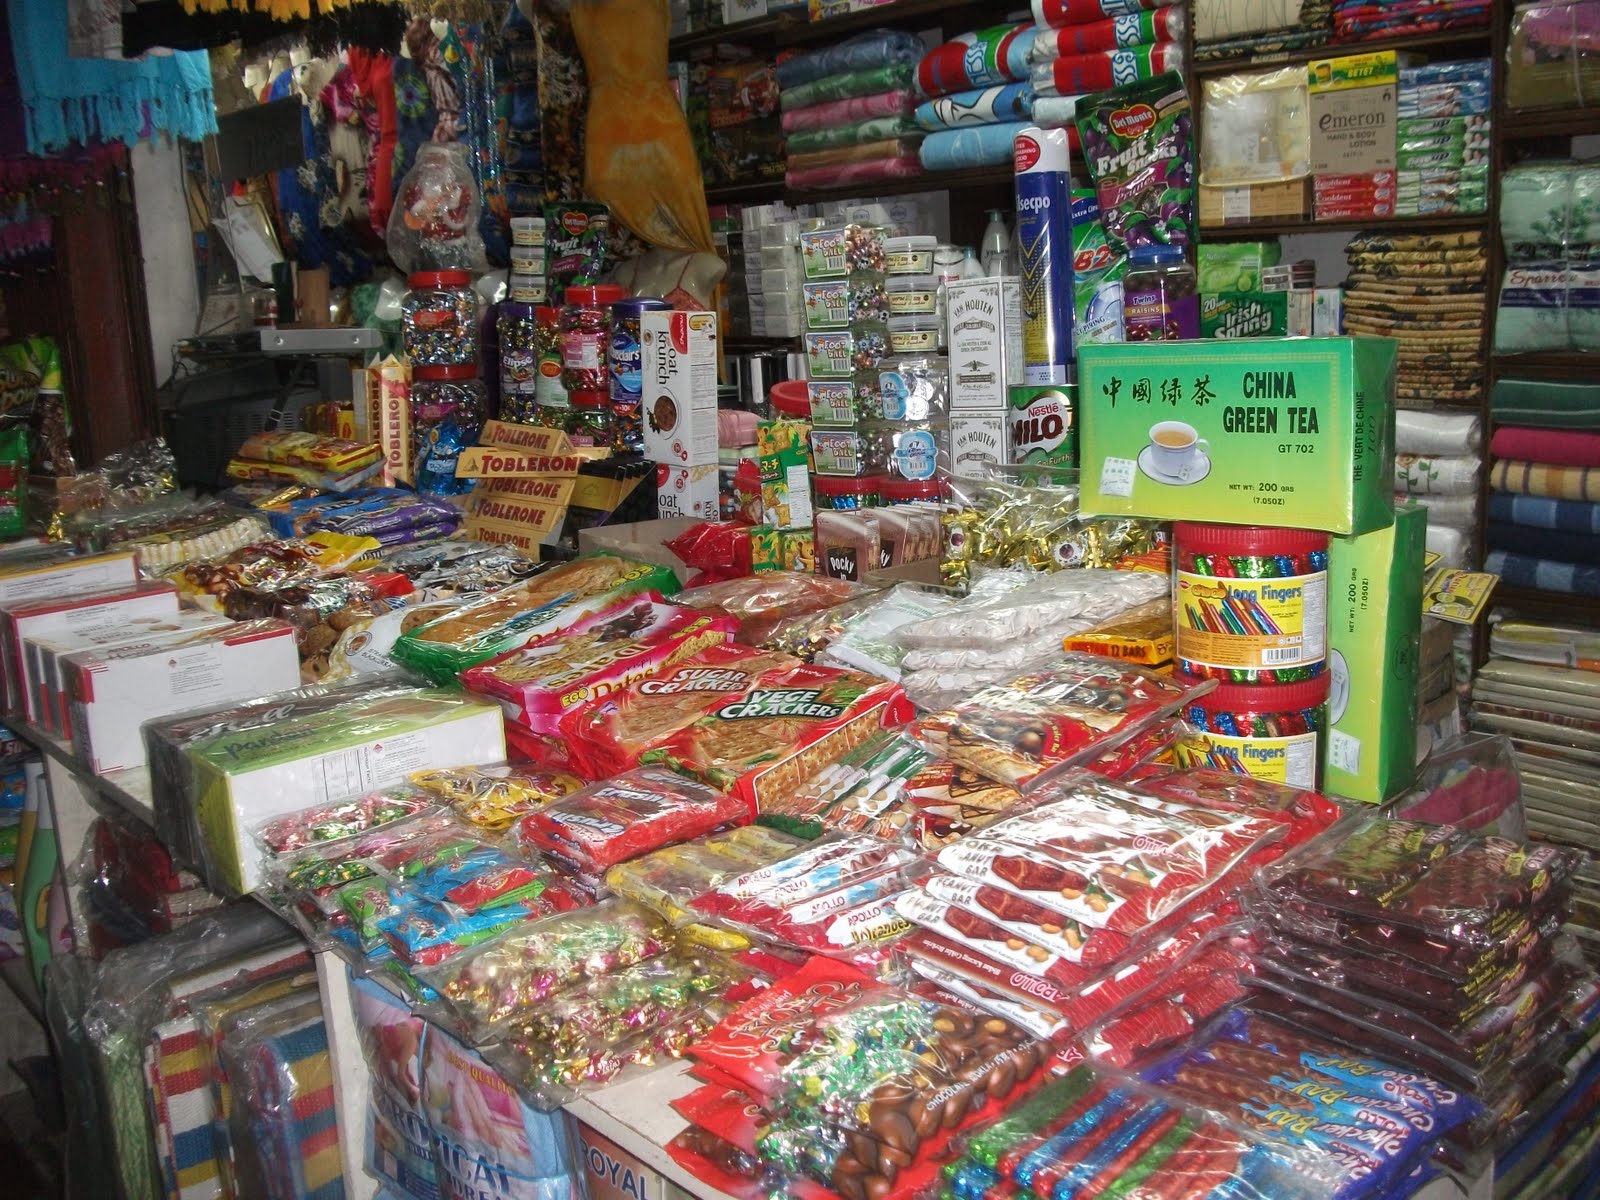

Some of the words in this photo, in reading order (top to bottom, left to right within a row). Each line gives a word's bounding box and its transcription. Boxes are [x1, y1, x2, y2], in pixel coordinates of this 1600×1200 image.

[1112, 118, 1125, 129] Del
[1125, 110, 1153, 125] Monte
[1318, 112, 1386, 131] emeron
[1096, 136, 1148, 177] Fruit
[1126, 143, 1178, 177] Snacks
[964, 299, 994, 316] HOUTEN
[1131, 306, 1160, 314] RAISINS
[1203, 298, 1216, 311] 20
[1214, 310, 1272, 338] Spring
[1226, 301, 1261, 329] Irish
[657, 331, 670, 385] krunch
[668, 347, 678, 376] oat
[1242, 371, 1297, 399] CHINA
[1027, 402, 1059, 419] Nestlé
[1355, 391, 1365, 420] CHINE
[1222, 405, 1278, 434] GREEN
[1287, 406, 1320, 434] TEA
[1355, 421, 1364, 435] DE
[491, 424, 551, 450] TOBLERONE
[968, 430, 997, 449] HOUTEN
[1010, 413, 1064, 448] MILO
[1278, 445, 1292, 454] GT
[1295, 445, 1314, 454] 702
[1354, 437, 1364, 460] VERT
[488, 478, 562, 499] TOBLERONE
[1258, 482, 1278, 492] 200
[659, 495, 678, 508] oat
[475, 500, 547, 526] TOBLERONE
[830, 555, 856, 575] Pocky
[1227, 585, 1258, 603] Long
[1261, 584, 1303, 603] Fingers
[1347, 583, 1357, 604] 200
[1111, 644, 1120, 658] 12
[1122, 645, 1146, 658] BARS
[672, 668, 746, 682] SUGAR
[640, 680, 750, 695] CRACKERS
[750, 690, 818, 704] VEGE
[560, 686, 589, 709] EGO
[719, 702, 840, 719] CRACKERS
[1212, 740, 1240, 760] Long
[1243, 743, 1286, 763] Fingers
[951, 892, 972, 905] BAR
